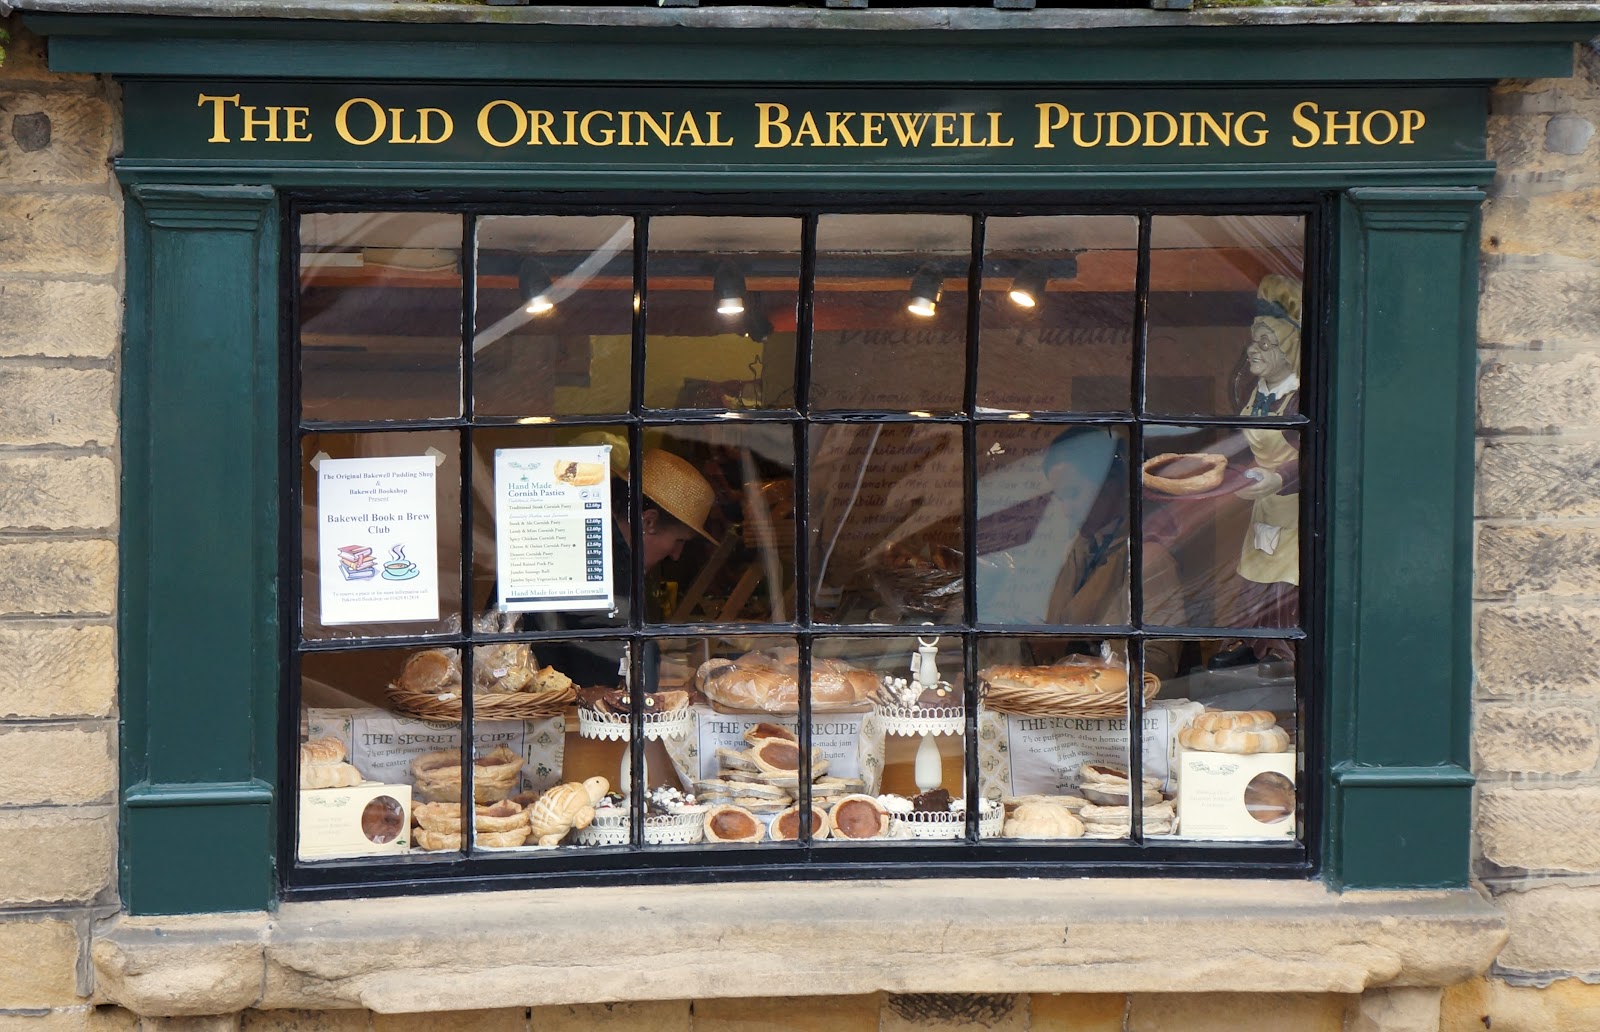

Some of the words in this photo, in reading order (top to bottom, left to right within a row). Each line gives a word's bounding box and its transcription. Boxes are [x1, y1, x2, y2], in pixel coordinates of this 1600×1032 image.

[198, 93, 312, 143] THE
[335, 98, 454, 144] OLD
[477, 99, 733, 147] ORIGINAL
[754, 102, 1014, 149] BAKEWELL
[1035, 102, 1270, 149] PUDDING
[1291, 100, 1426, 148] SHOP
[327, 514, 368, 522] Bakewell
[372, 513, 395, 522] Book
[368, 526, 390, 534] Club
[710, 722, 740, 734] THE
[1018, 718, 1047, 731] THE
[1050, 717, 1104, 731] SECRET
[1108, 719, 1159, 731] REPE
[362, 734, 393, 745] THE
[398, 734, 456, 745] SECRET
[472, 732, 515, 742] ECIPE
[386, 748, 401, 757] puff
[1062, 751, 1077, 760] fresh
[386, 759, 407, 768] caster
